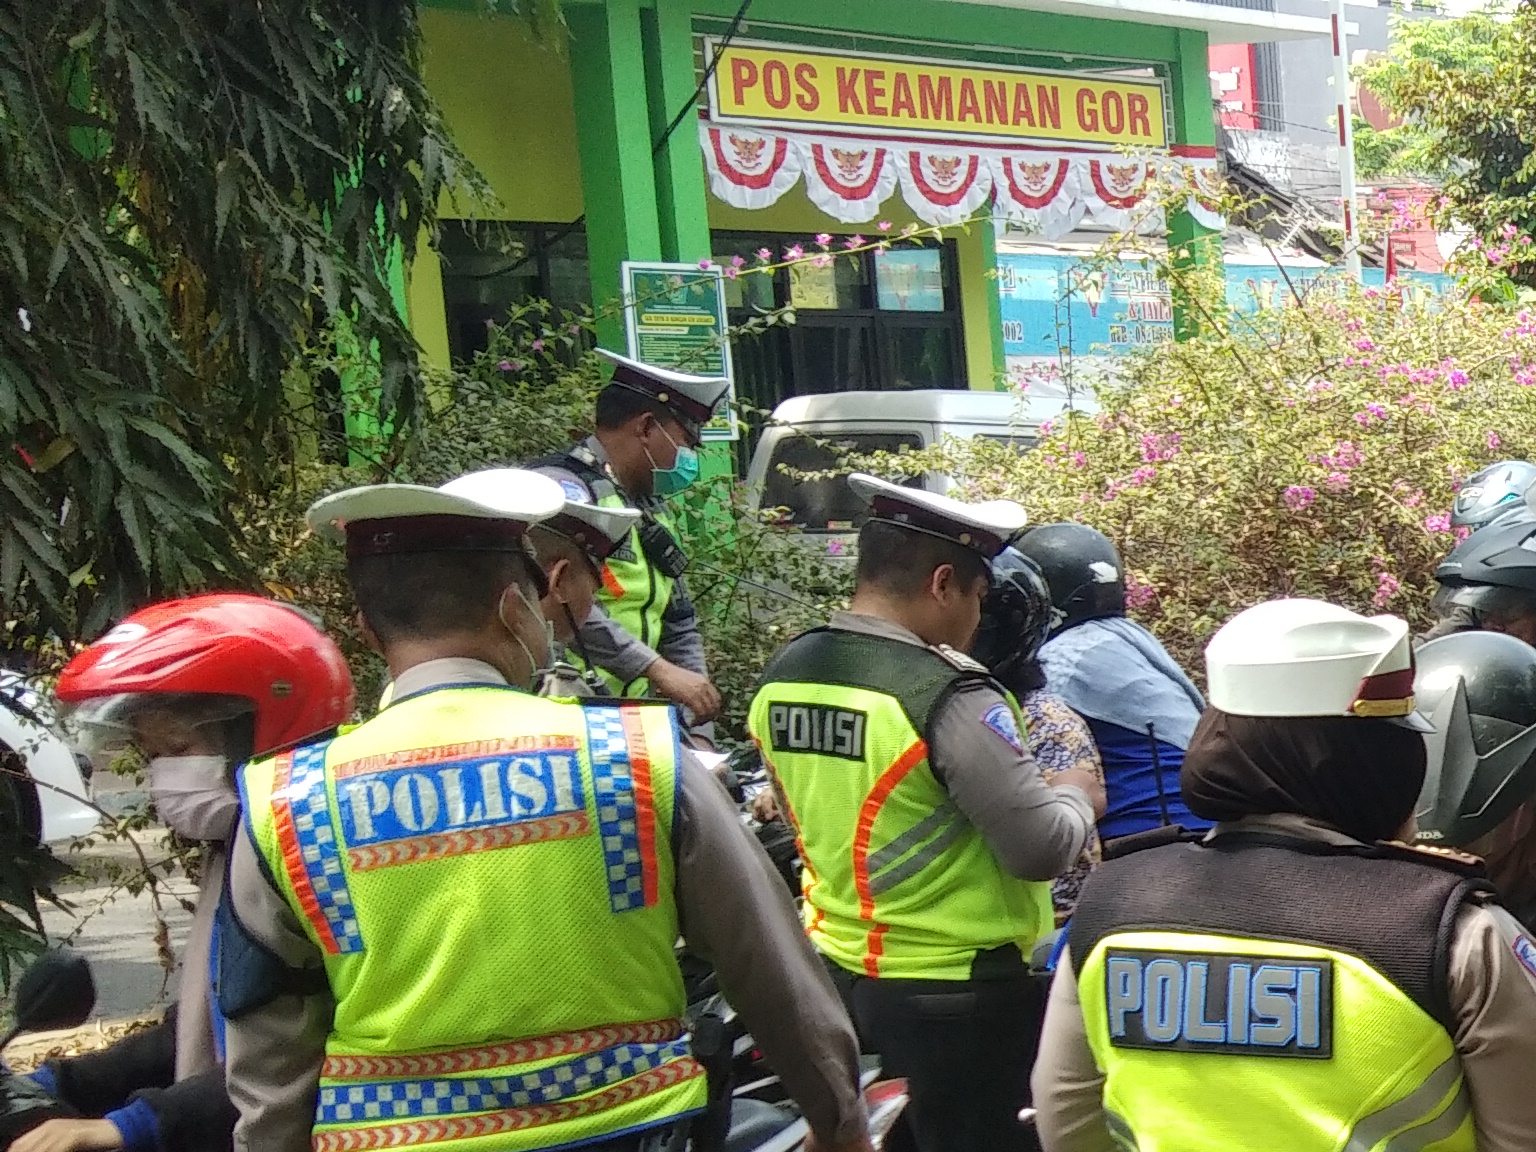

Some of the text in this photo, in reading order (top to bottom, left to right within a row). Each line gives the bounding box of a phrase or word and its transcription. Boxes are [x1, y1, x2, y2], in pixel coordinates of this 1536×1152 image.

[731, 57, 1153, 136] POS KEAMANAN GOR
[769, 705, 865, 757] POLISI
[346, 755, 579, 841] POLISI
[1108, 957, 1322, 1048] POLISI
